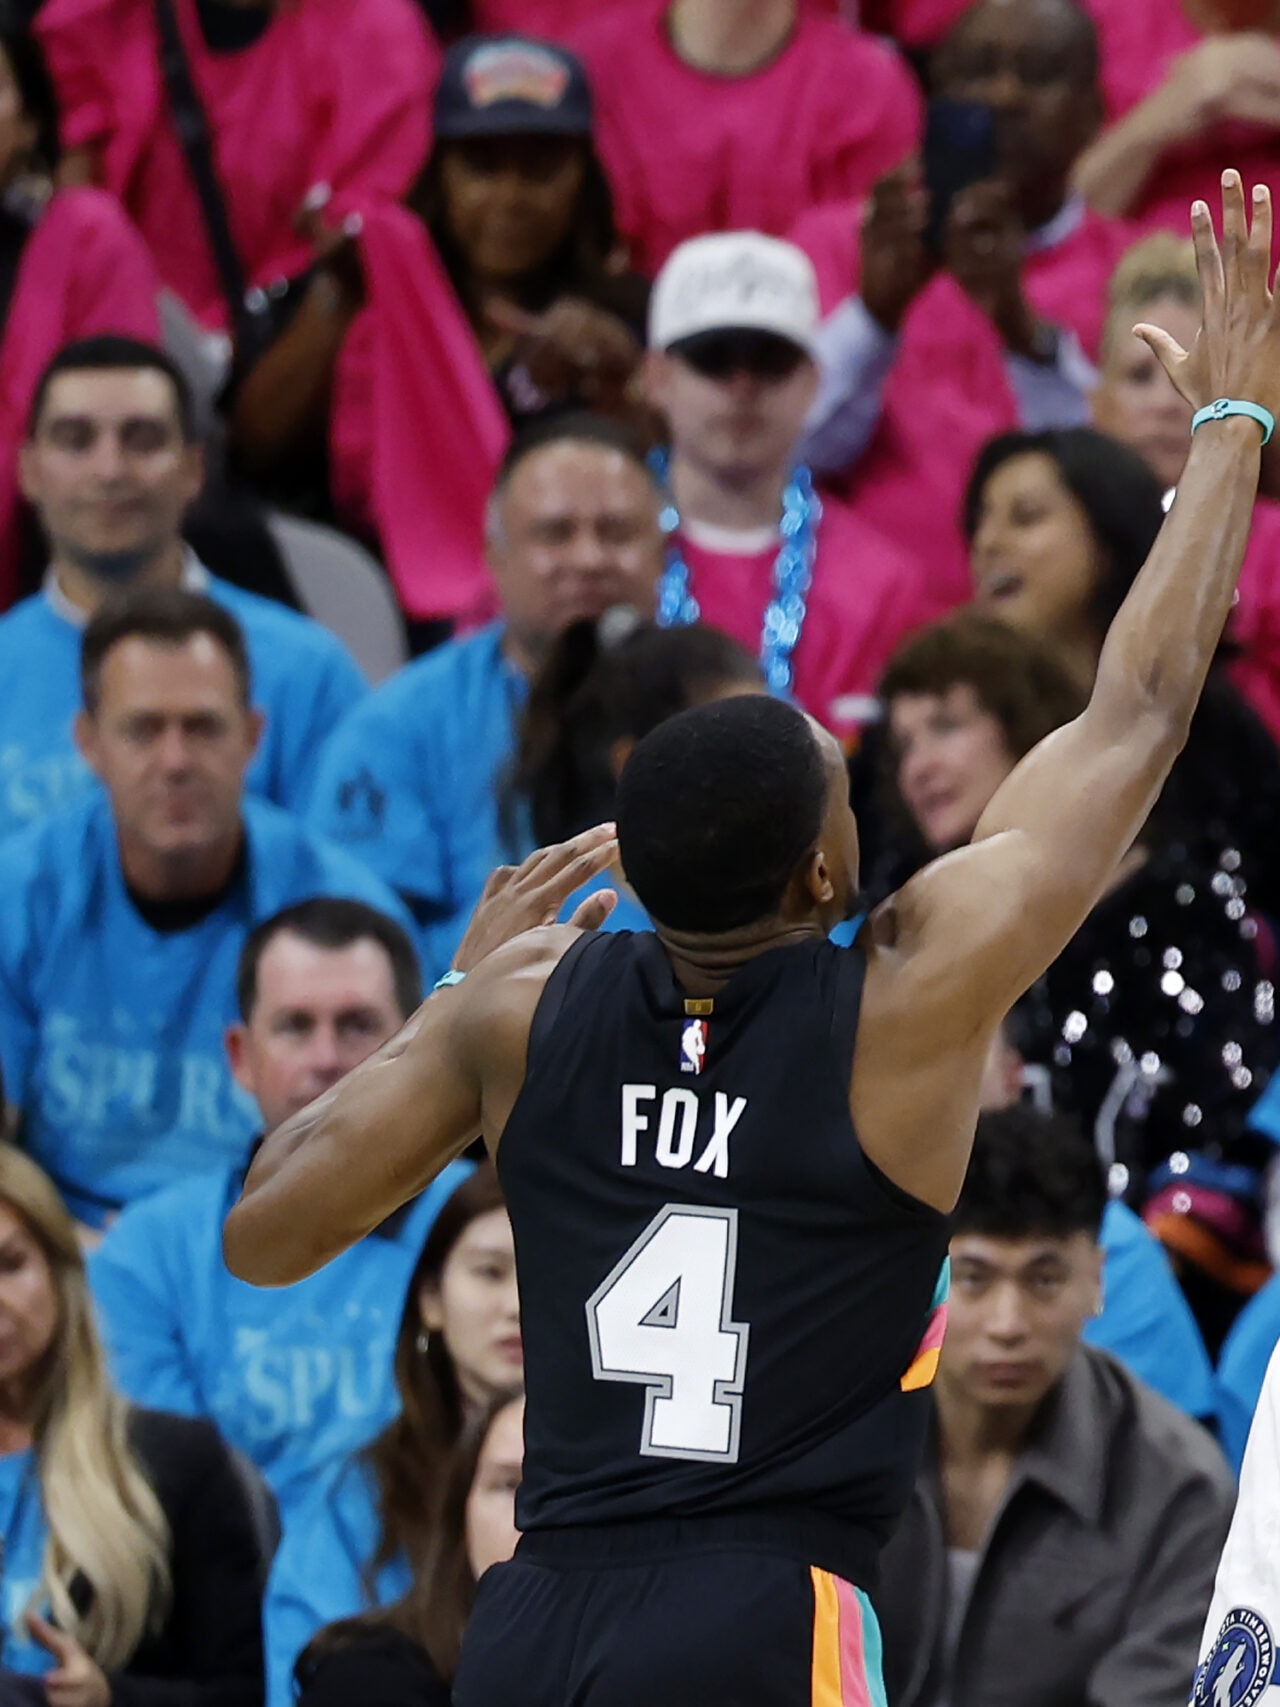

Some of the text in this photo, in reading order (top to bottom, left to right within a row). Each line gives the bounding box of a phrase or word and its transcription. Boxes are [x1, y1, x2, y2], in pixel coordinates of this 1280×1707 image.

[620, 1083, 748, 1179] FOX
[585, 1202, 750, 1464] 4
[245, 1339, 390, 1441] SPU
[1237, 1610, 1271, 1707] TIMBERWOLVE
